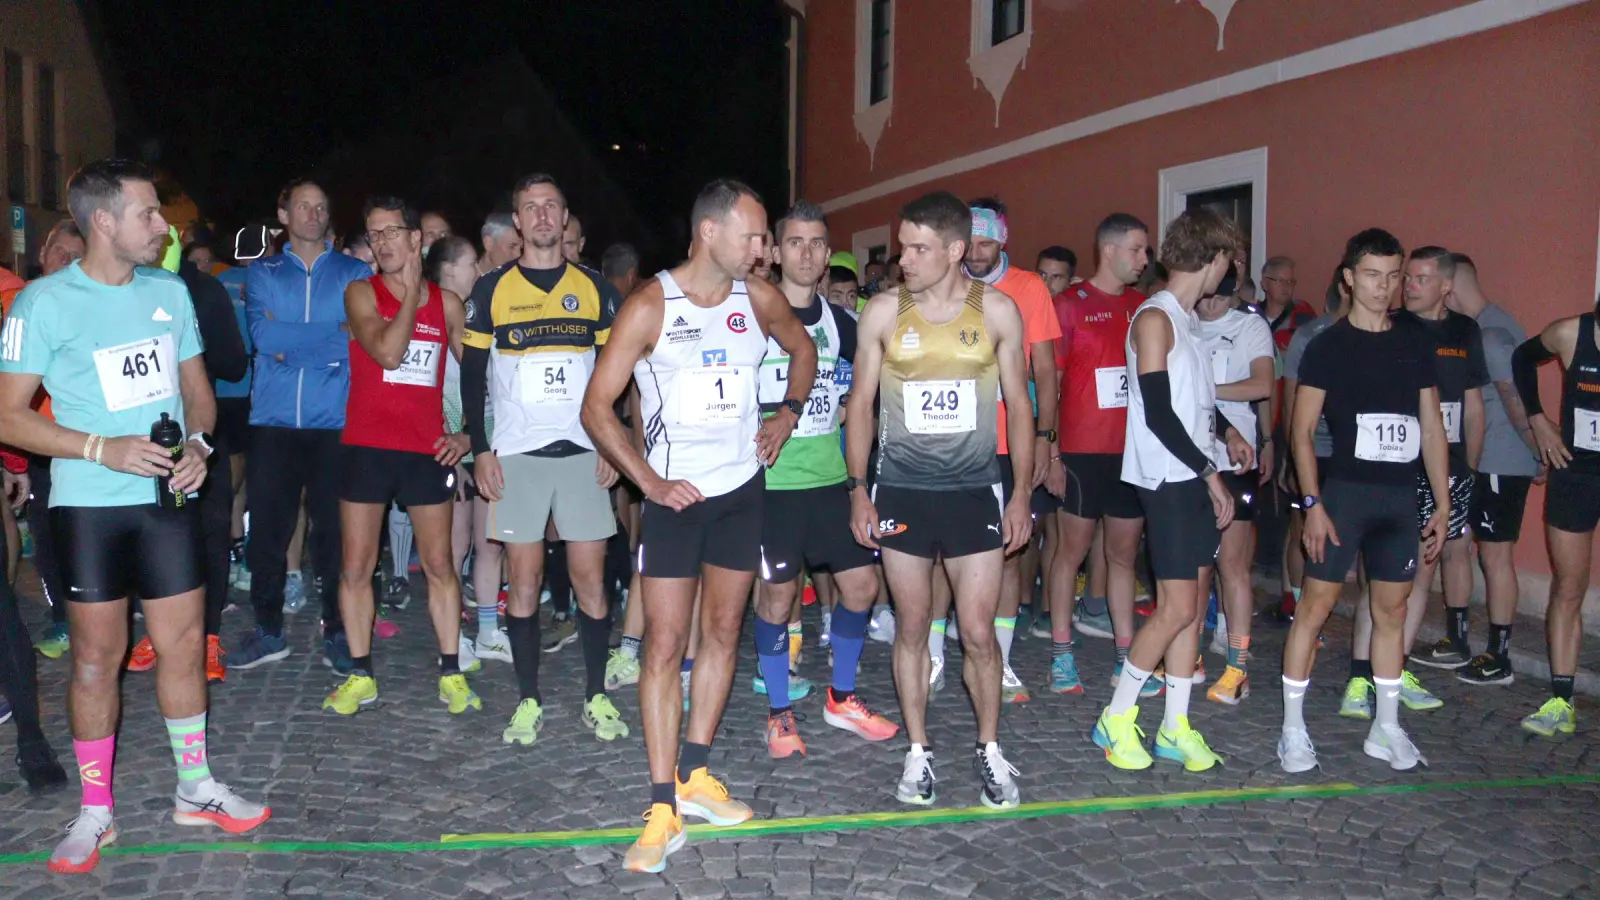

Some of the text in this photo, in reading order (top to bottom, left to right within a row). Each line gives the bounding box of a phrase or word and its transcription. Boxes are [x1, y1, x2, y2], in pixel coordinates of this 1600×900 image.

[122, 349, 161, 379] 461
[544, 366, 566, 385] 54
[543, 387, 567, 395] Georg
[714, 378, 724, 399] 1
[807, 395, 831, 416] 285
[921, 389, 959, 411] 249
[812, 416, 828, 424] Frank
[922, 413, 959, 421] Theodor
[1375, 423, 1407, 443] 119
[1379, 443, 1404, 452] Tobias
